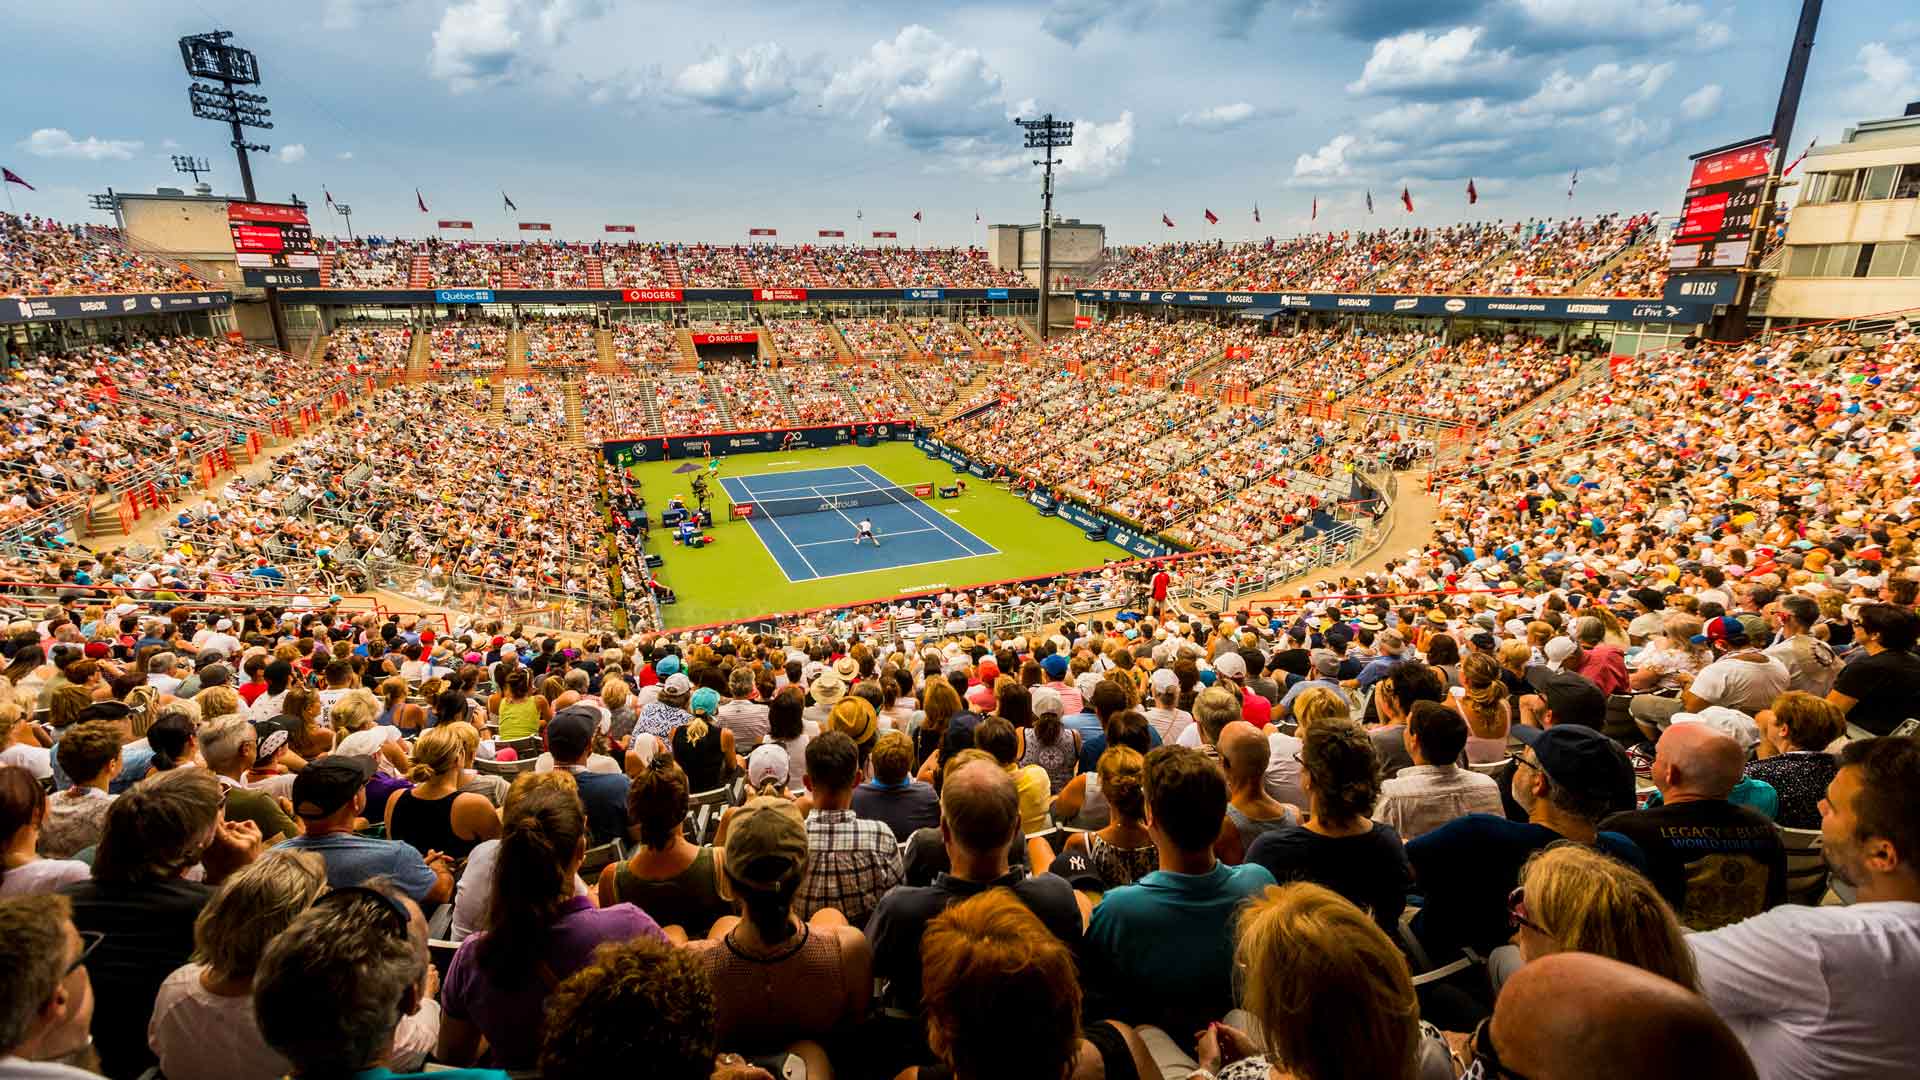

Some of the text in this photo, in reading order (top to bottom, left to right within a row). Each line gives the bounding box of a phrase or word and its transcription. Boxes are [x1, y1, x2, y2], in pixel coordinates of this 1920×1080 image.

[278, 276, 303, 284] IRIS
[1692, 282, 1718, 295] IRIS
[441, 291, 475, 301] Québec
[641, 291, 676, 299] ROGERS
[1566, 304, 1610, 314] LISTERINE
[1660, 826, 1720, 838] LEGACY
[1671, 838, 1720, 849] WORLD
